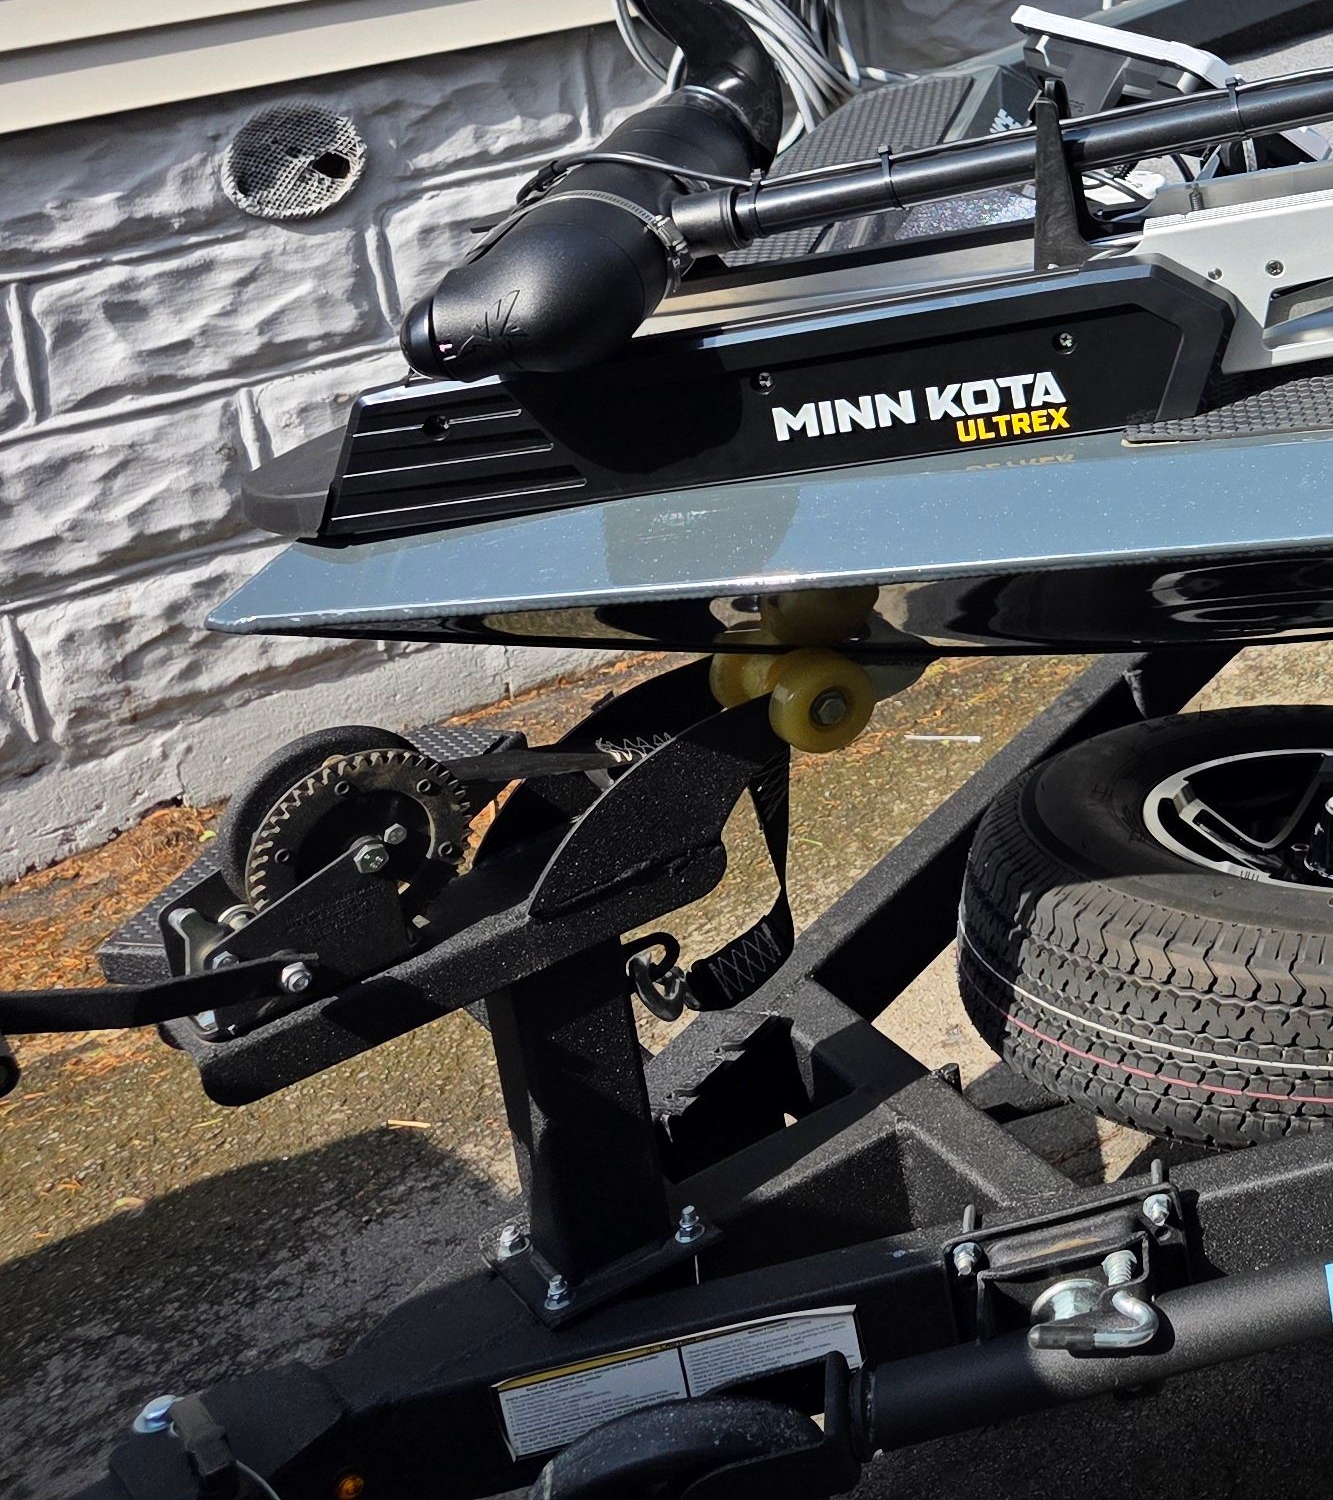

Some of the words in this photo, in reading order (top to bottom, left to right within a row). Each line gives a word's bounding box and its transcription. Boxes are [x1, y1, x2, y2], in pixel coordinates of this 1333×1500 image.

[772, 387, 917, 442] MINN
[923, 371, 1068, 422] KOTA
[956, 406, 1070, 443] ULTREX
